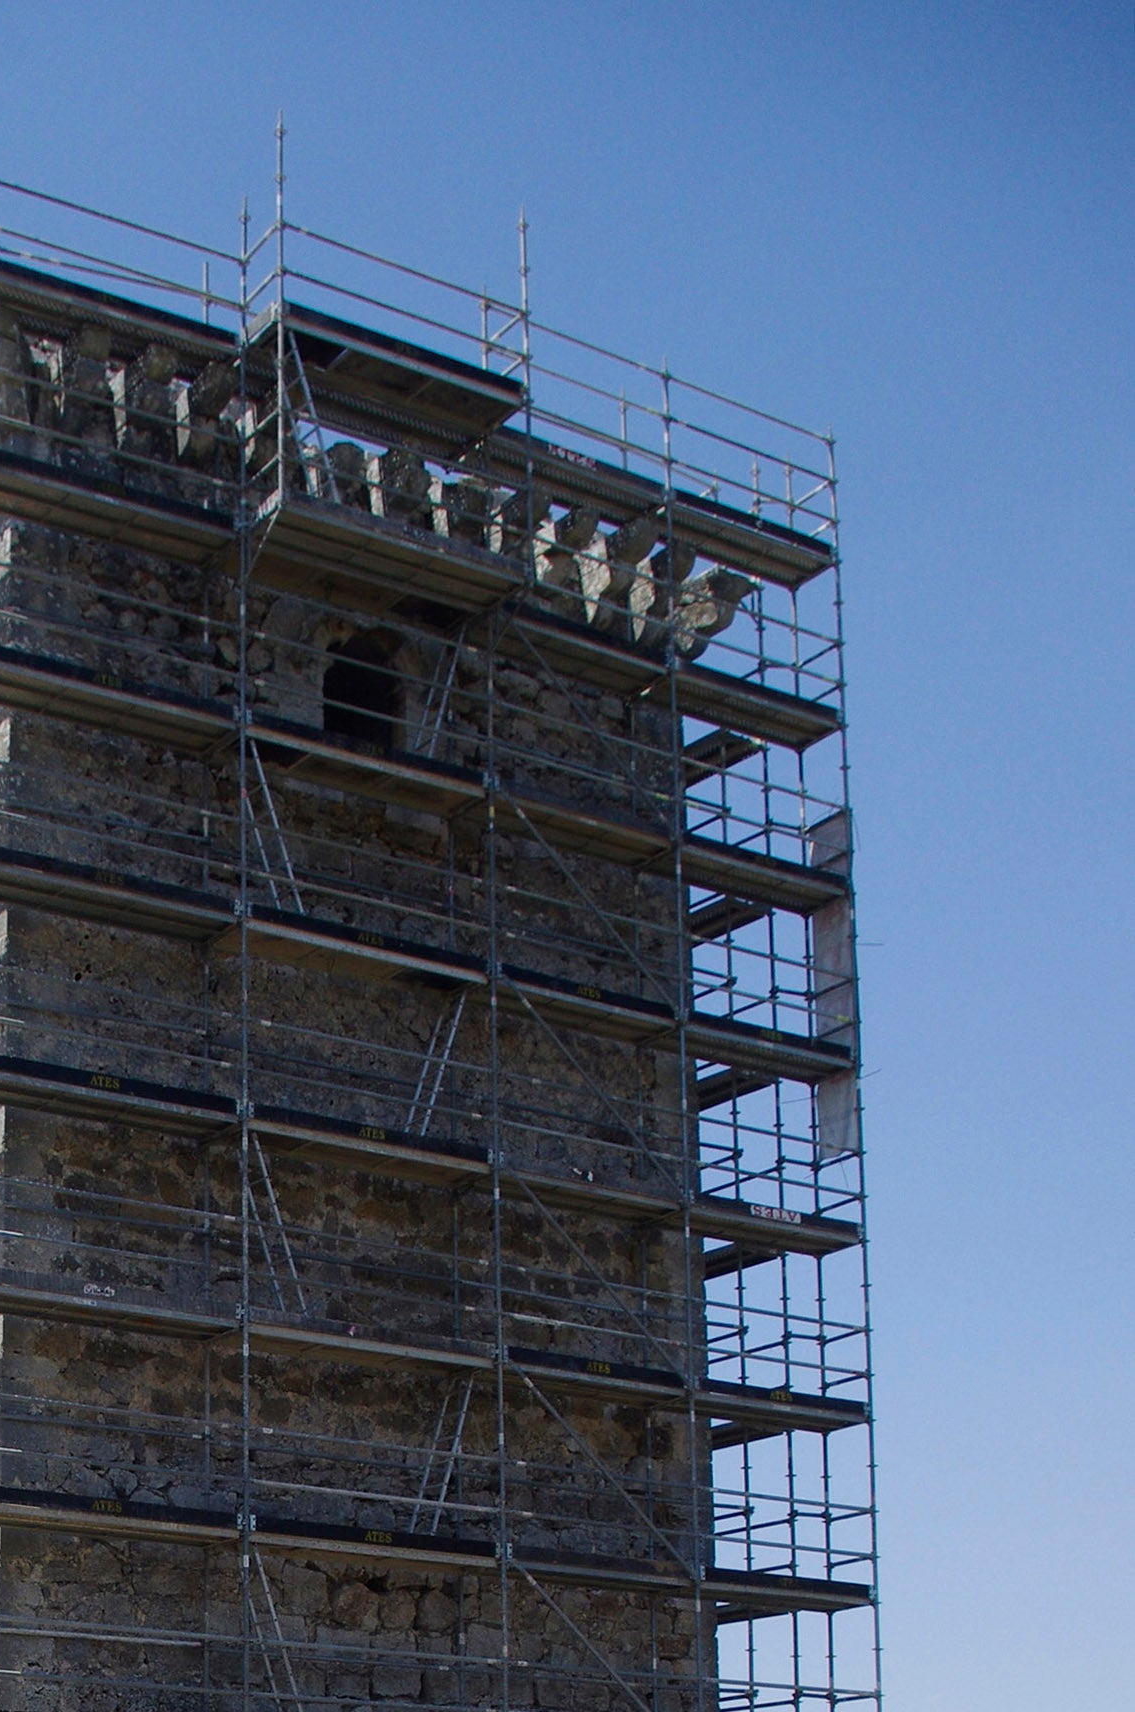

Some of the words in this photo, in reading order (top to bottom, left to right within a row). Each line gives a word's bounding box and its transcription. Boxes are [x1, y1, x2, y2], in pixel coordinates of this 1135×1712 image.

[95, 871, 124, 886] ATES
[357, 932, 384, 946] ATES
[90, 1075, 120, 1089] ATES
[359, 1127, 385, 1140] ATES
[586, 1362, 610, 1374] ATES
[92, 1500, 122, 1513] ATES
[364, 1531, 393, 1543] ATES
